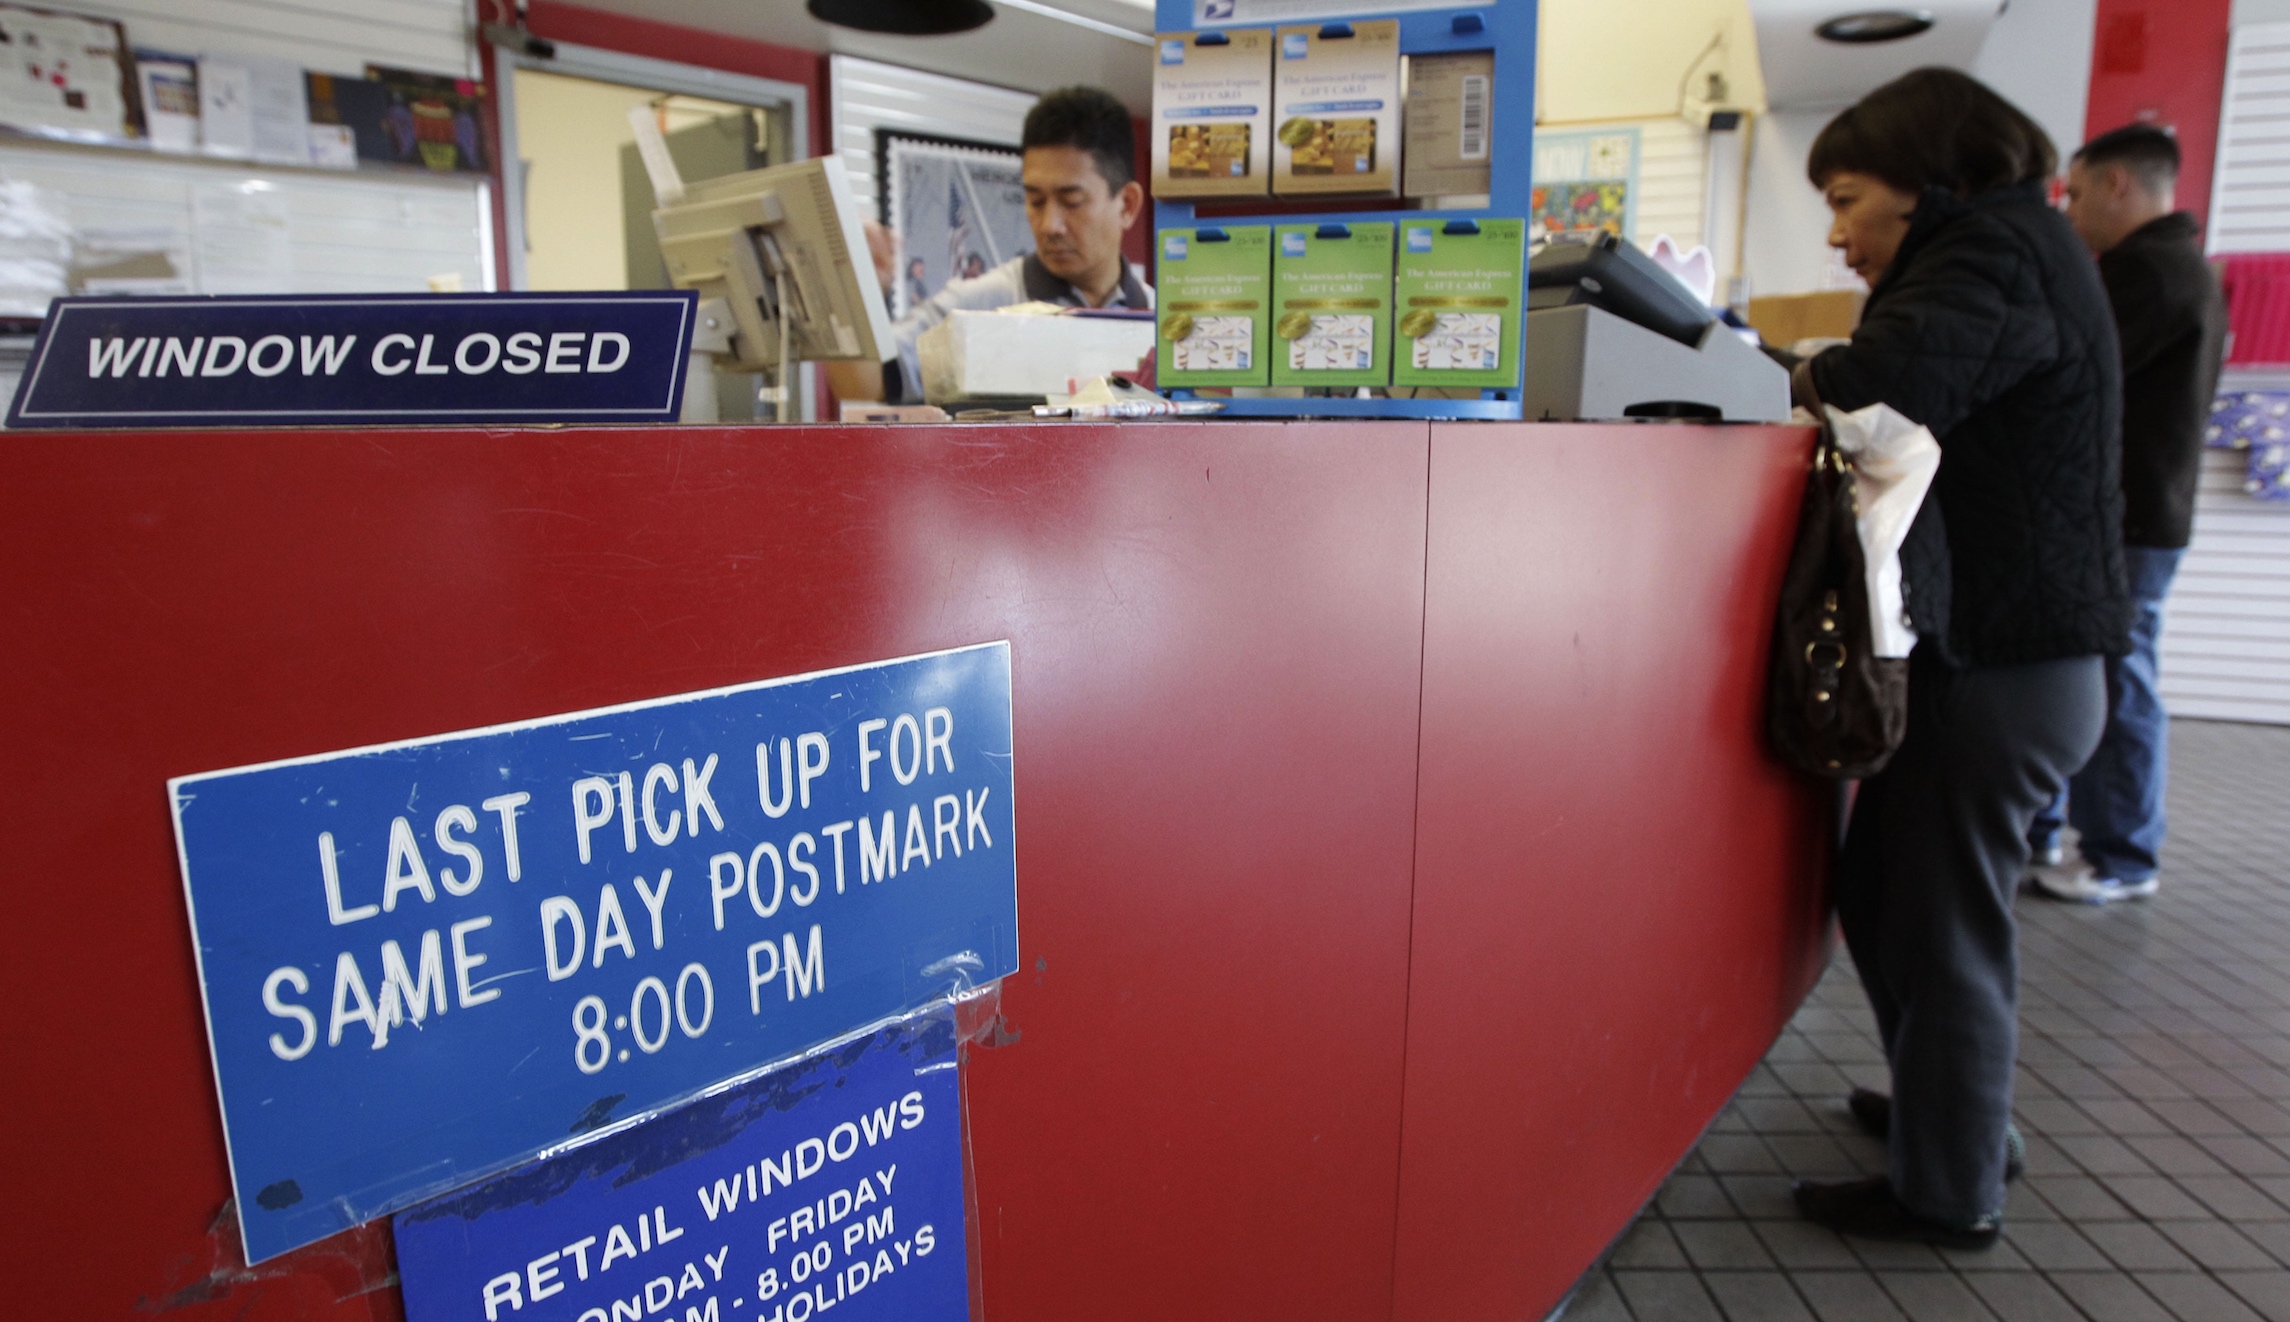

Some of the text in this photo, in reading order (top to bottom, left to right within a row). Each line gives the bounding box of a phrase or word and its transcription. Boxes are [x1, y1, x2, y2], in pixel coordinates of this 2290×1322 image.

[88, 331, 631, 379] WINDOW CLOSED
[319, 705, 956, 927] LAST PICK UP FOR
[262, 786, 992, 1060] SAME DAY POSTMARK
[571, 924, 825, 1075] 8:00 PM
[482, 1090, 925, 1322] RETAIL WINDOWS
[757, 1240, 832, 1301] 8.00
[843, 1205, 895, 1256] PM
[767, 1163, 897, 1255] FRIDAY
